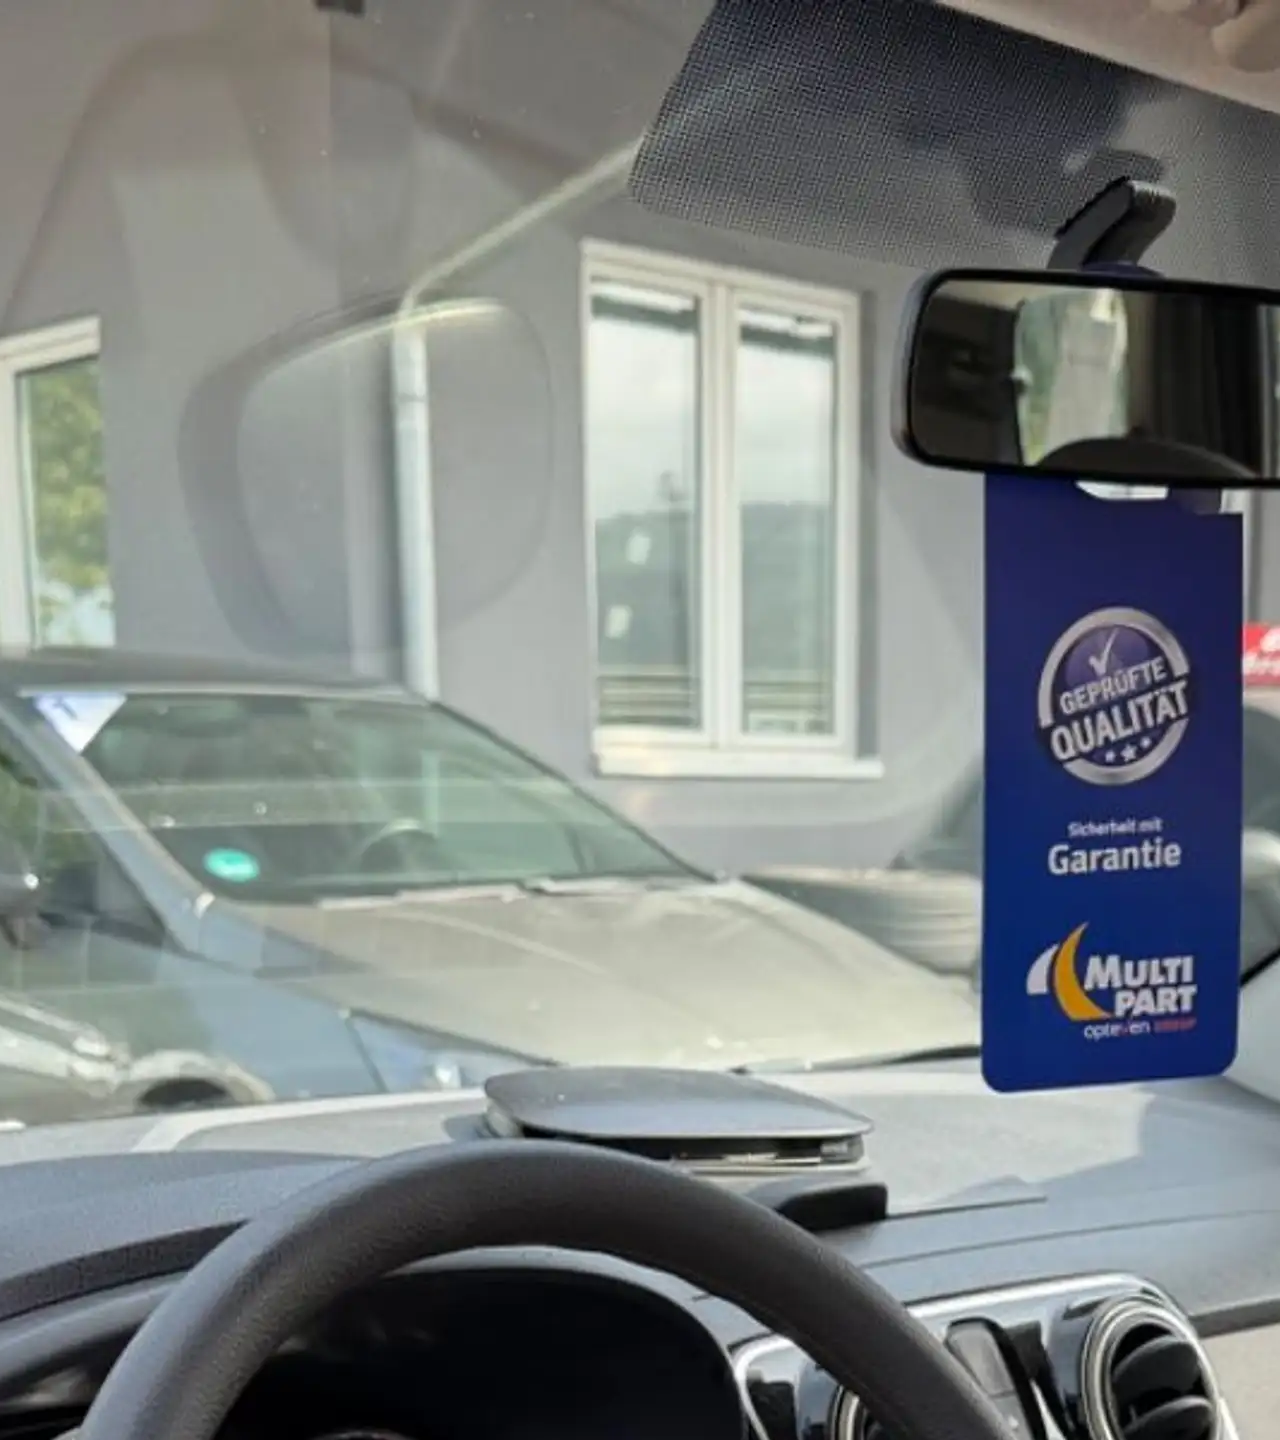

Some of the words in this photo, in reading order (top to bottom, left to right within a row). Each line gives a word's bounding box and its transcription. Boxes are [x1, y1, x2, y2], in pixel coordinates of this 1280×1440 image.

[1058, 655, 1168, 716] GEPRÜFTE
[1050, 679, 1189, 762] QUALITÄT
[1047, 838, 1182, 877] Garantie
[1114, 984, 1198, 1019] PART
